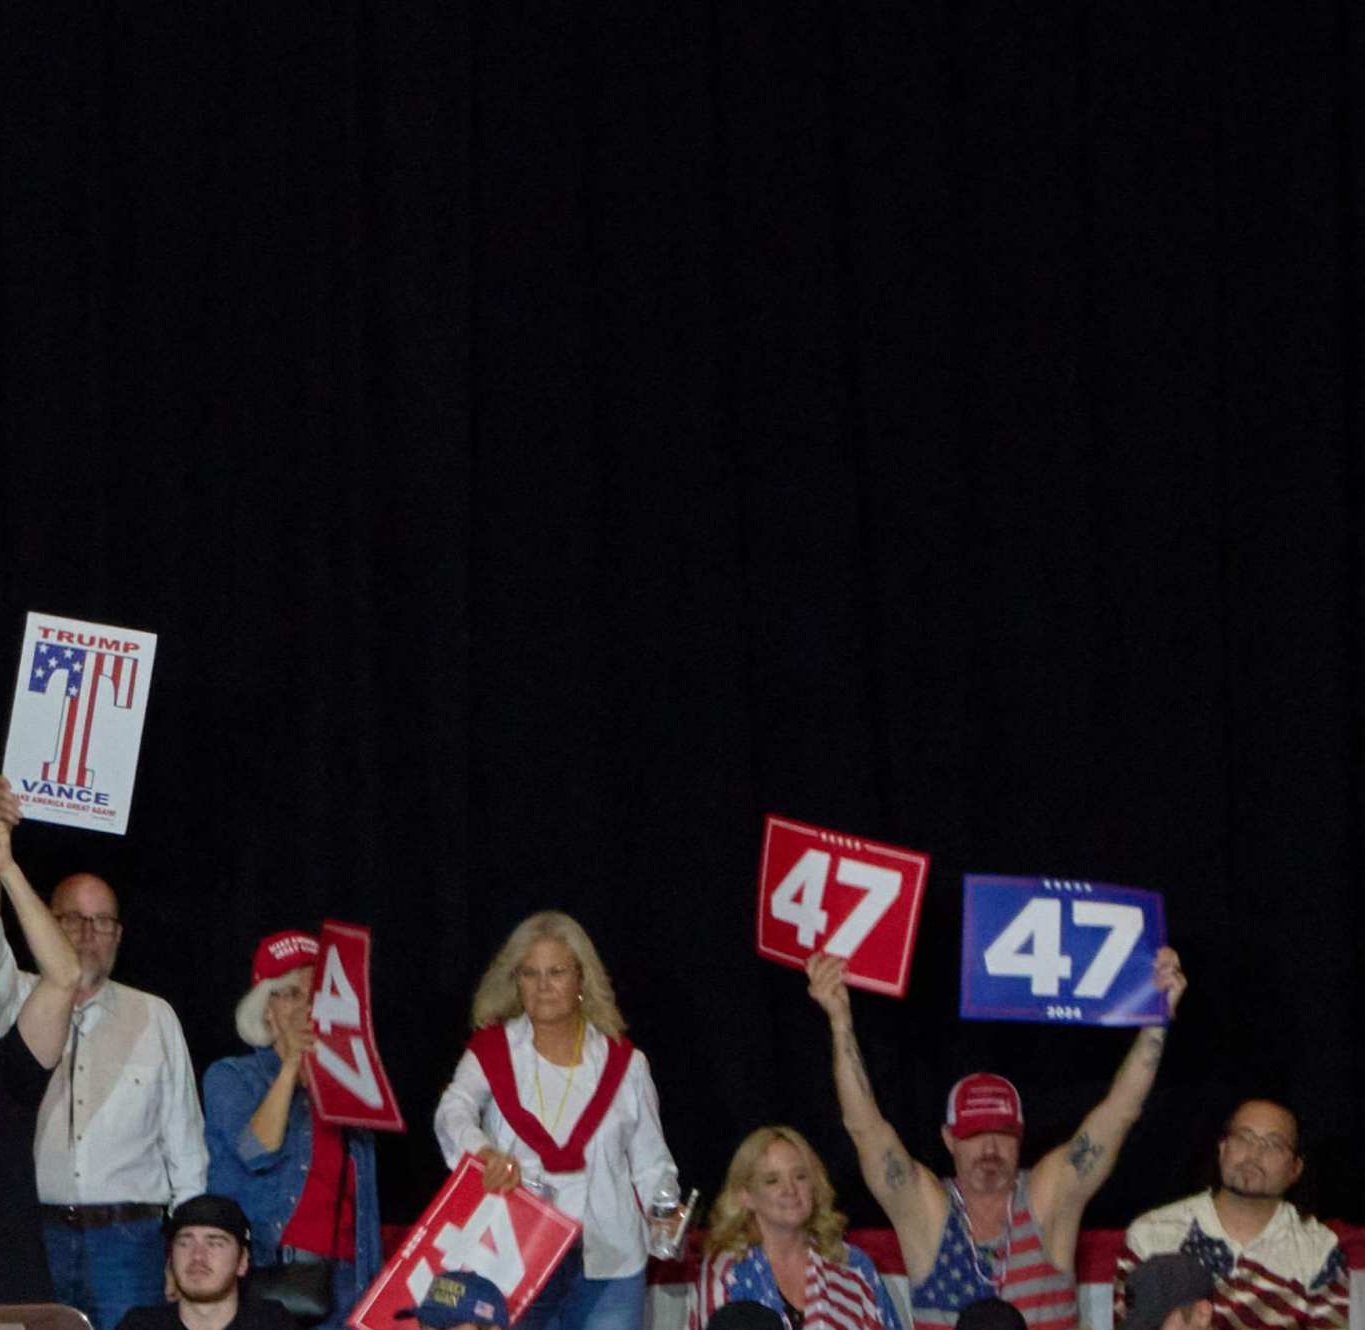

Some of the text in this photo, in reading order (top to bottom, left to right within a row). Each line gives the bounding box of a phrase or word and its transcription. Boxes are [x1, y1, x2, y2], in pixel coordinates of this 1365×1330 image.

[38, 626, 140, 653] TRUMP
[21, 779, 110, 806] VANCE
[771, 848, 902, 957] 47
[984, 898, 1144, 998] 47
[312, 945, 384, 1110] 47
